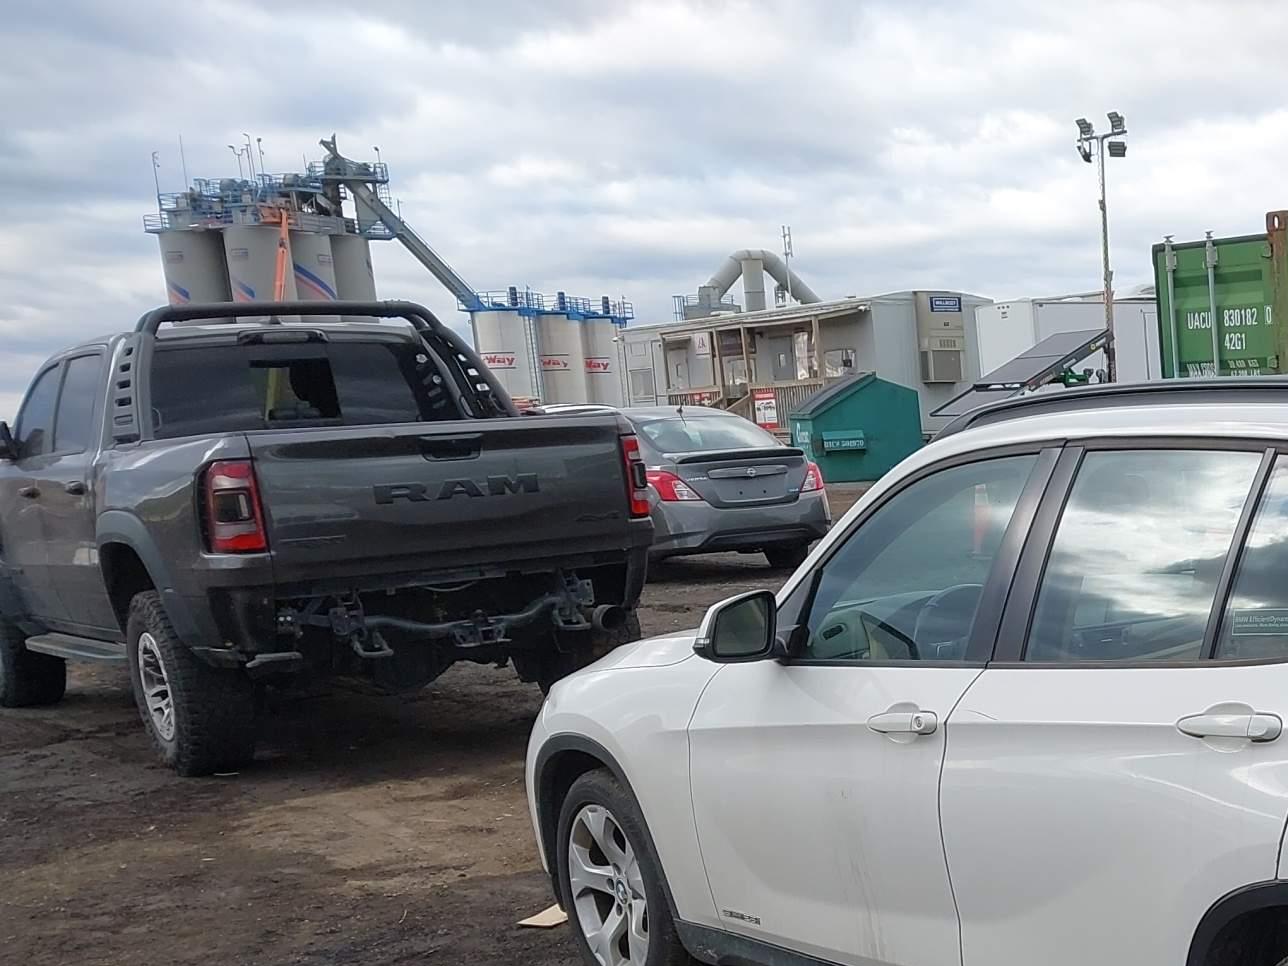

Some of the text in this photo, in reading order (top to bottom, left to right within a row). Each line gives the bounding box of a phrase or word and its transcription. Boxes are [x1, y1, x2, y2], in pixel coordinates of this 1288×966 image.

[1187, 312, 1212, 329] UACU
[1223, 308, 1258, 326] 830182
[1224, 333, 1246, 349] 42G1
[373, 473, 540, 504] RAM
